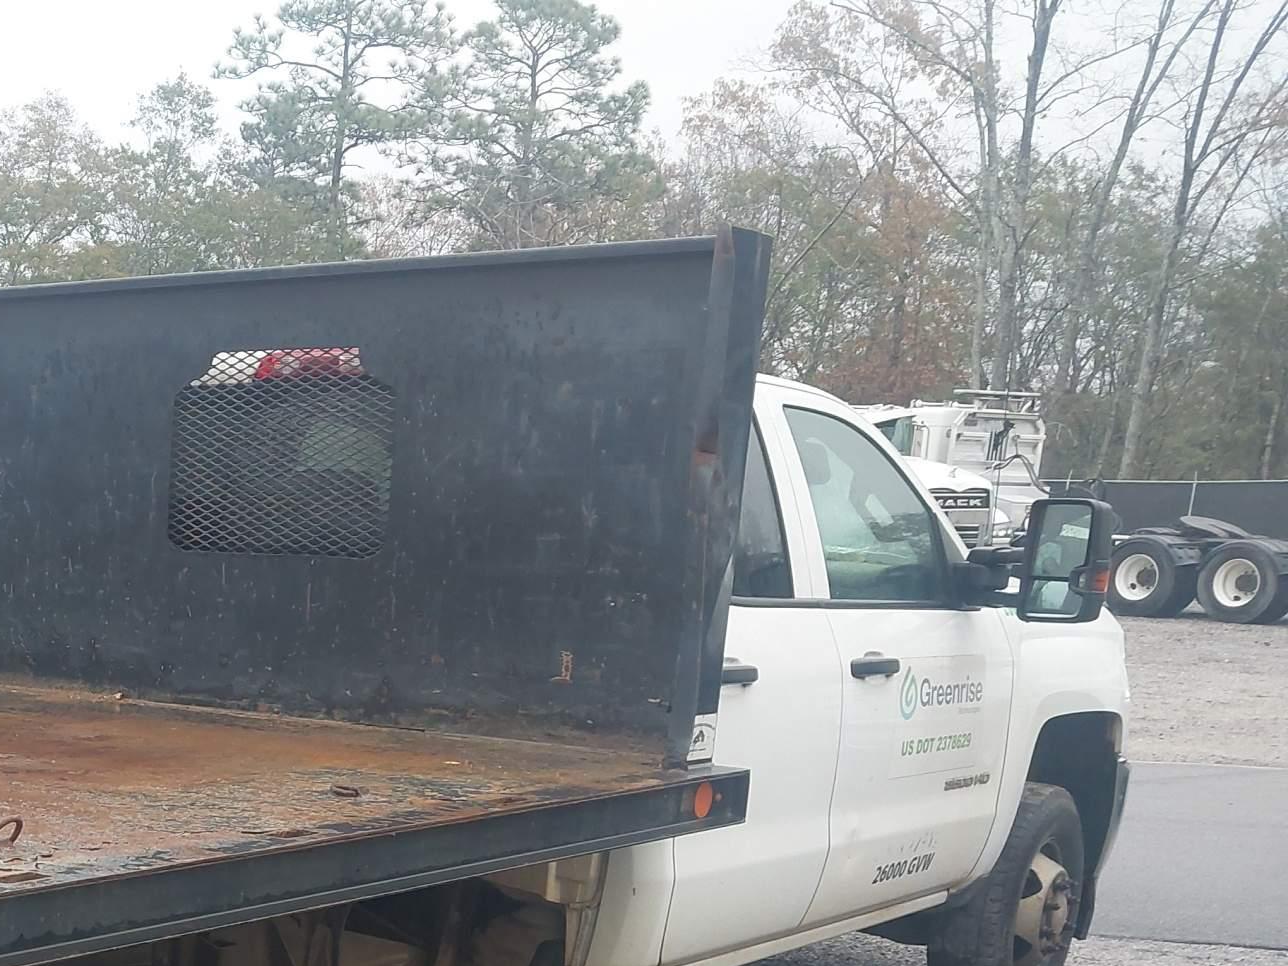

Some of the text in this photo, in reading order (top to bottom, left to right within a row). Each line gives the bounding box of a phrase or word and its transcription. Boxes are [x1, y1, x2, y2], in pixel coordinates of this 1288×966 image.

[920, 675, 983, 707] Greenrise
[901, 740, 915, 757] US
[915, 737, 936, 755] DOT
[872, 851, 936, 885] 26000 GVW
